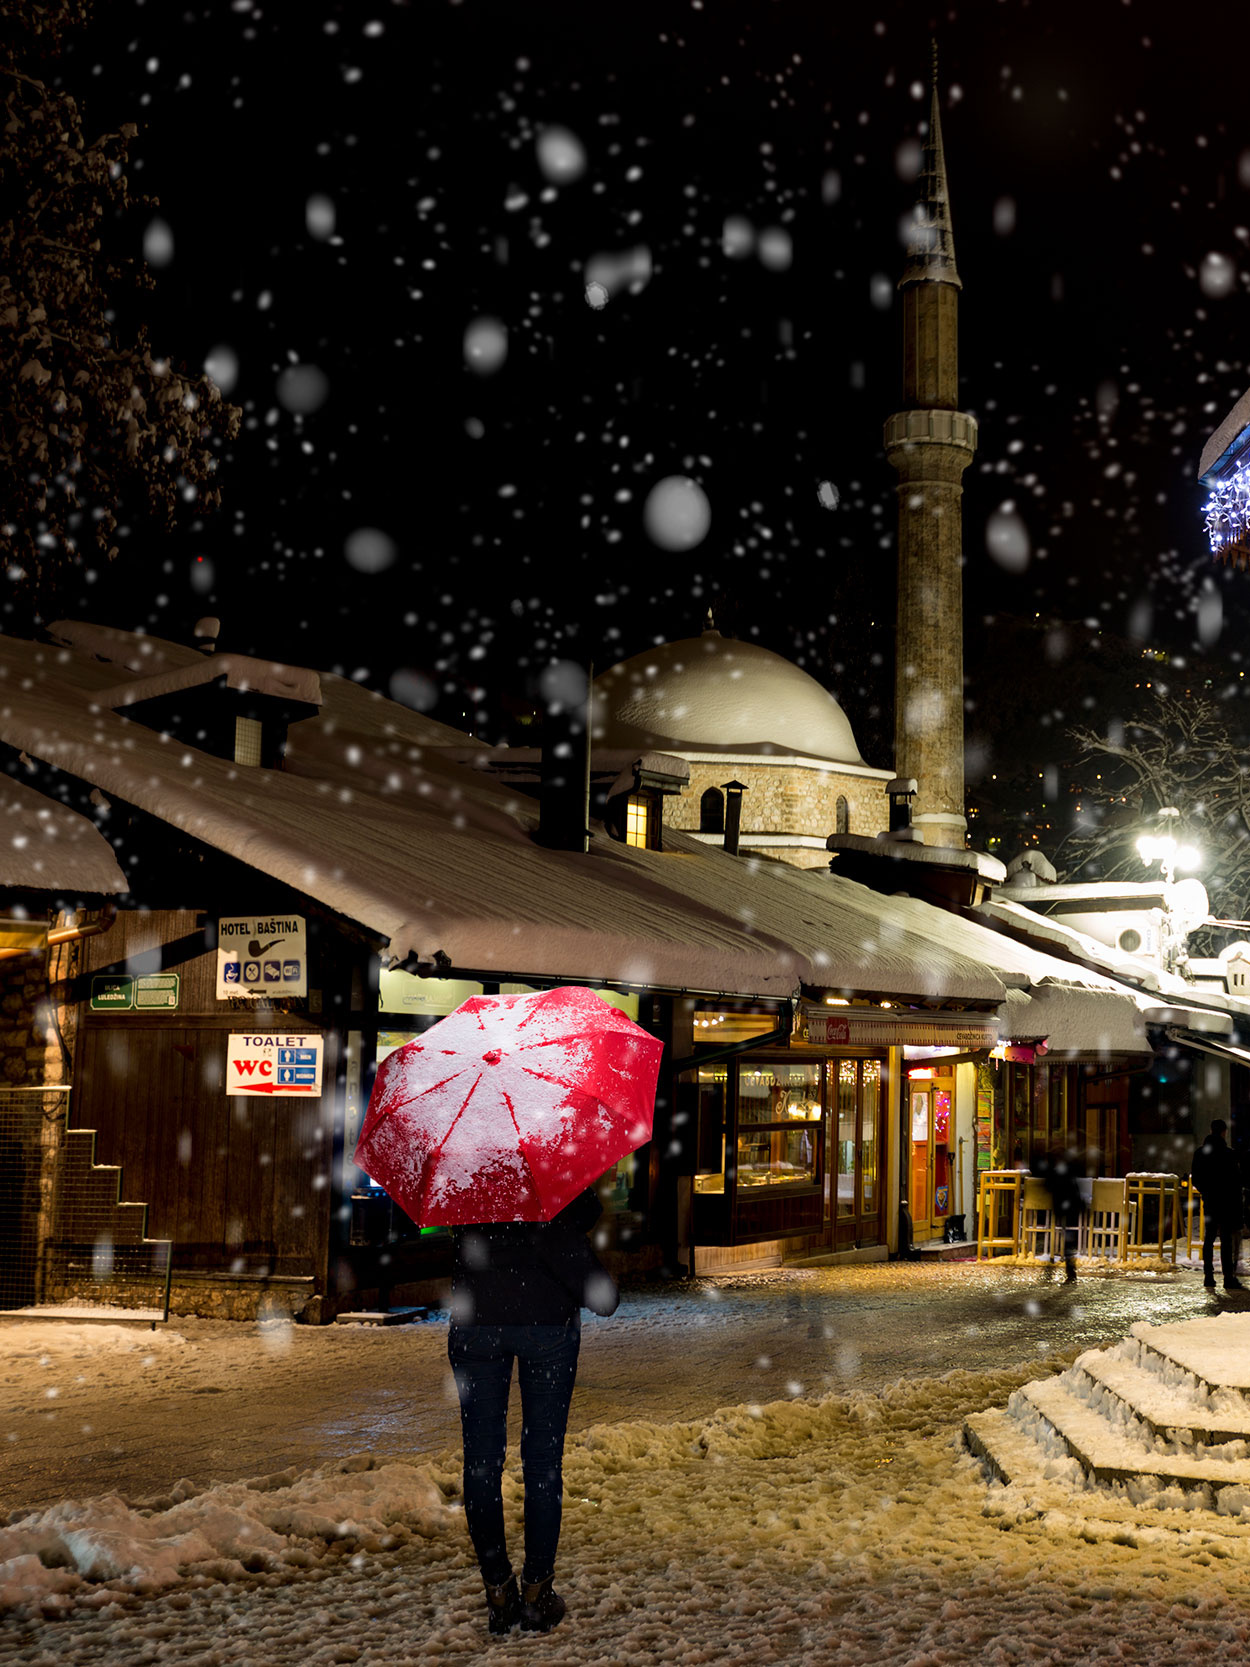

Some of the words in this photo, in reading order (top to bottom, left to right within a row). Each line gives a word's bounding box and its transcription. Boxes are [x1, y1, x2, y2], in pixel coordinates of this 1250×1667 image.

[221, 922, 251, 936] HOTEL
[257, 918, 299, 934] BAŠTINA
[243, 1036, 307, 1047] TOALET
[232, 1060, 273, 1076] WC
